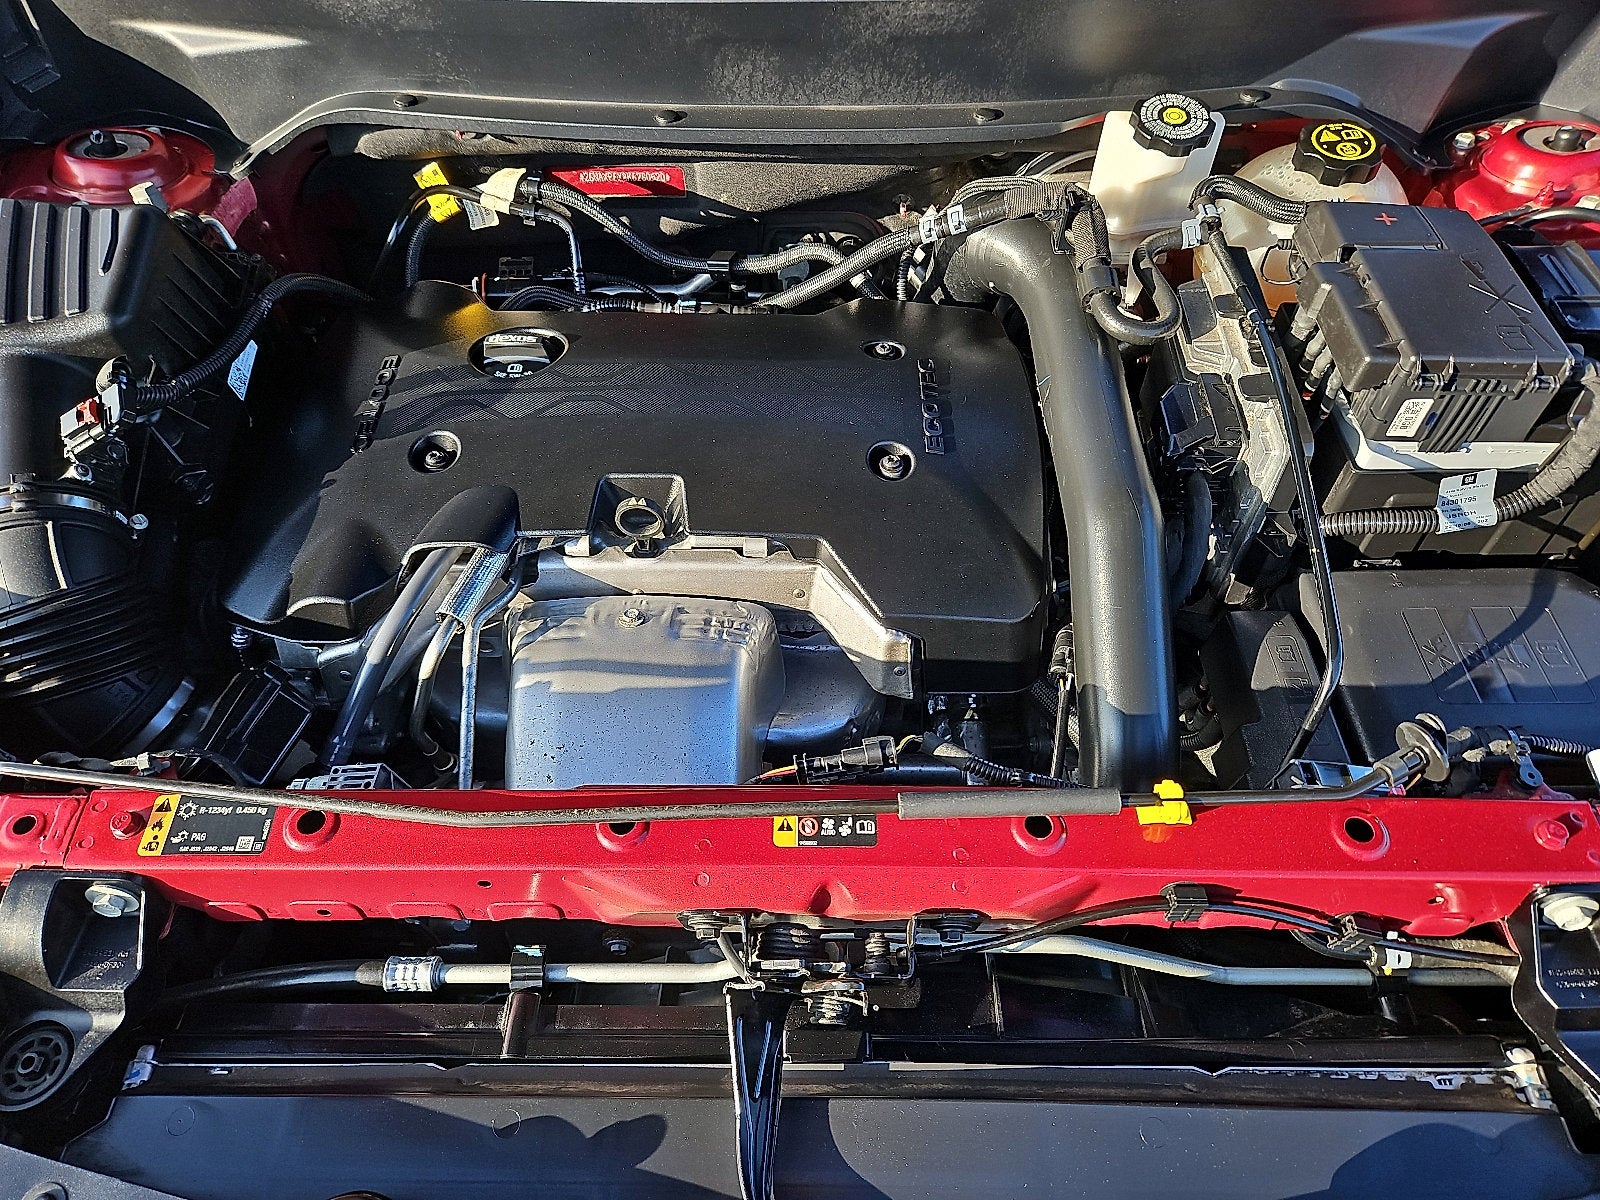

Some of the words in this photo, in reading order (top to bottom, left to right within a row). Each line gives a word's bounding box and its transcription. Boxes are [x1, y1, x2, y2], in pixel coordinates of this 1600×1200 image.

[488, 334, 538, 343] dexos
[917, 359, 945, 455] ECOTEC
[1441, 496, 1477, 507] 84301795
[199, 806, 232, 816] R-1234yf
[235, 806, 257, 815] 0.450
[257, 806, 268, 816] kg
[191, 832, 206, 841] PAG
